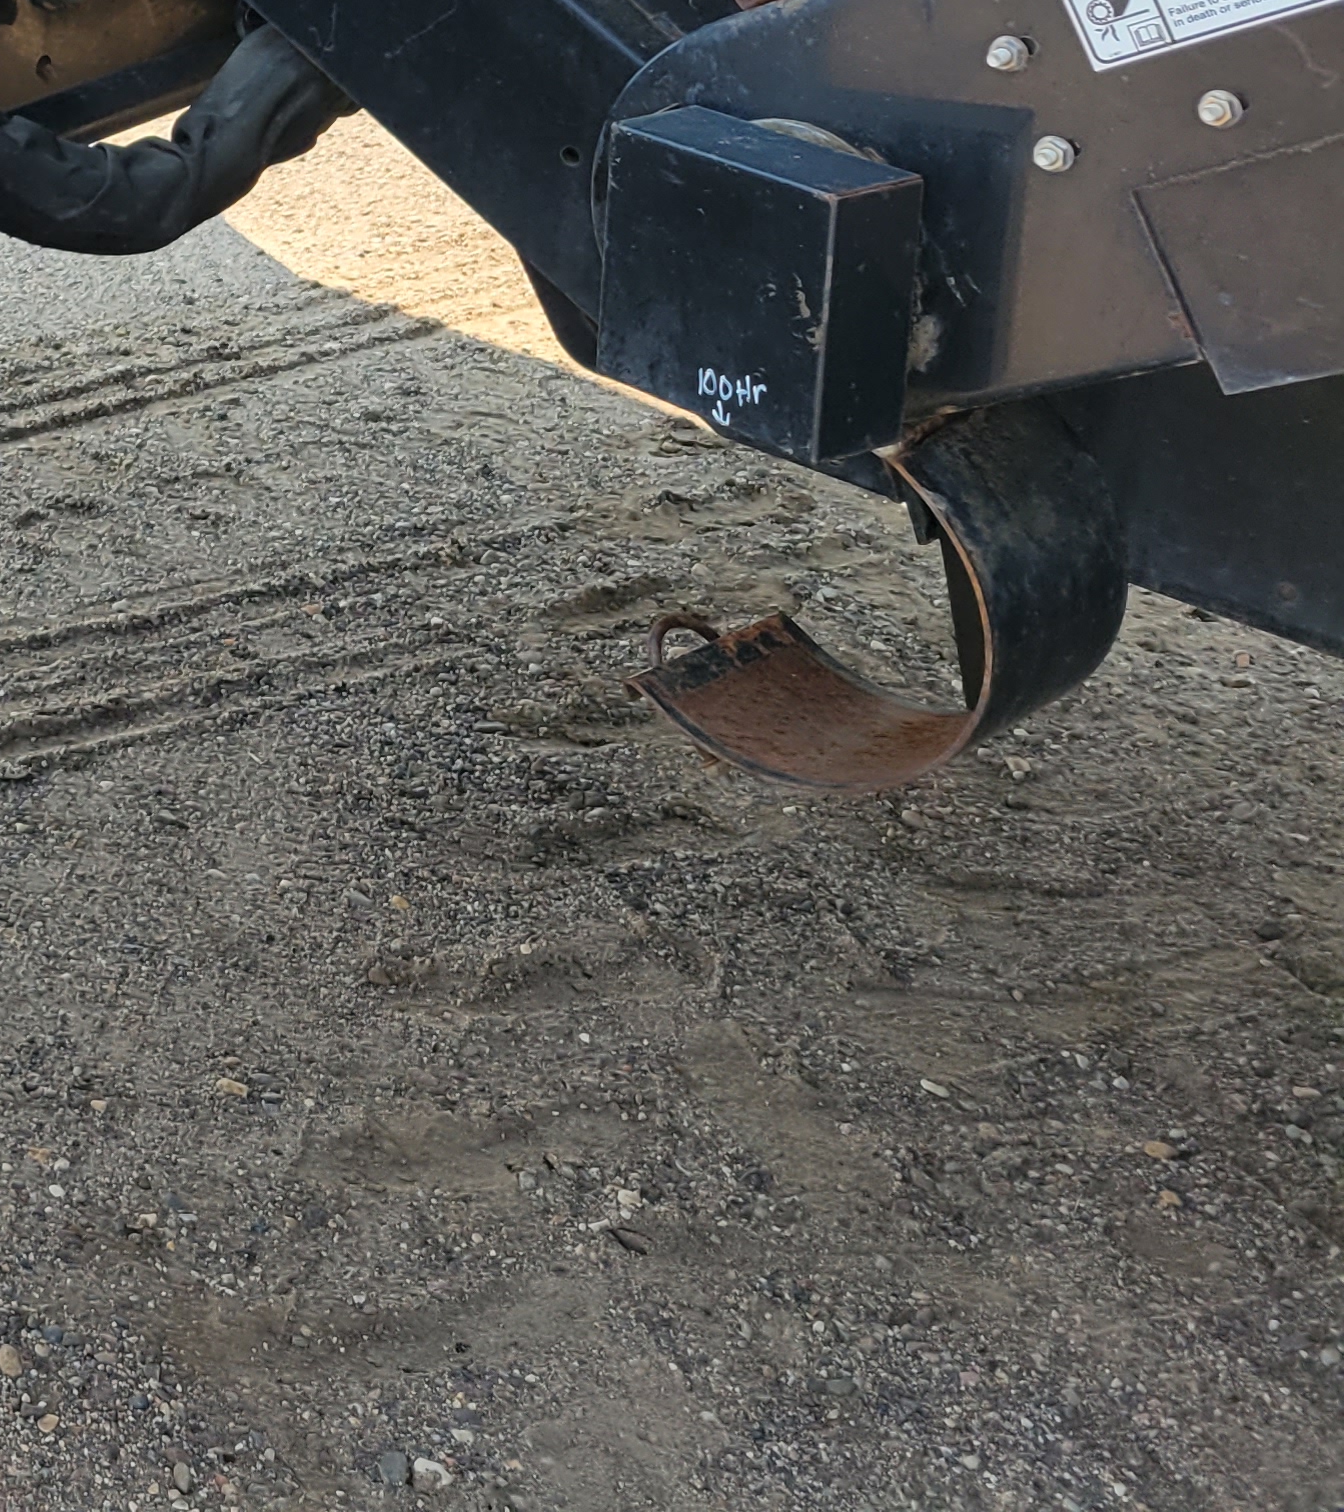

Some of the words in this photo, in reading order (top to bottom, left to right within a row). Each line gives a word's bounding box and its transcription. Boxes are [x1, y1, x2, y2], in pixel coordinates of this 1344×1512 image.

[1167, 0, 1205, 18] Failure
[1173, 18, 1186, 28] in
[1187, 9, 1218, 26] death
[1219, 3, 1232, 15] or
